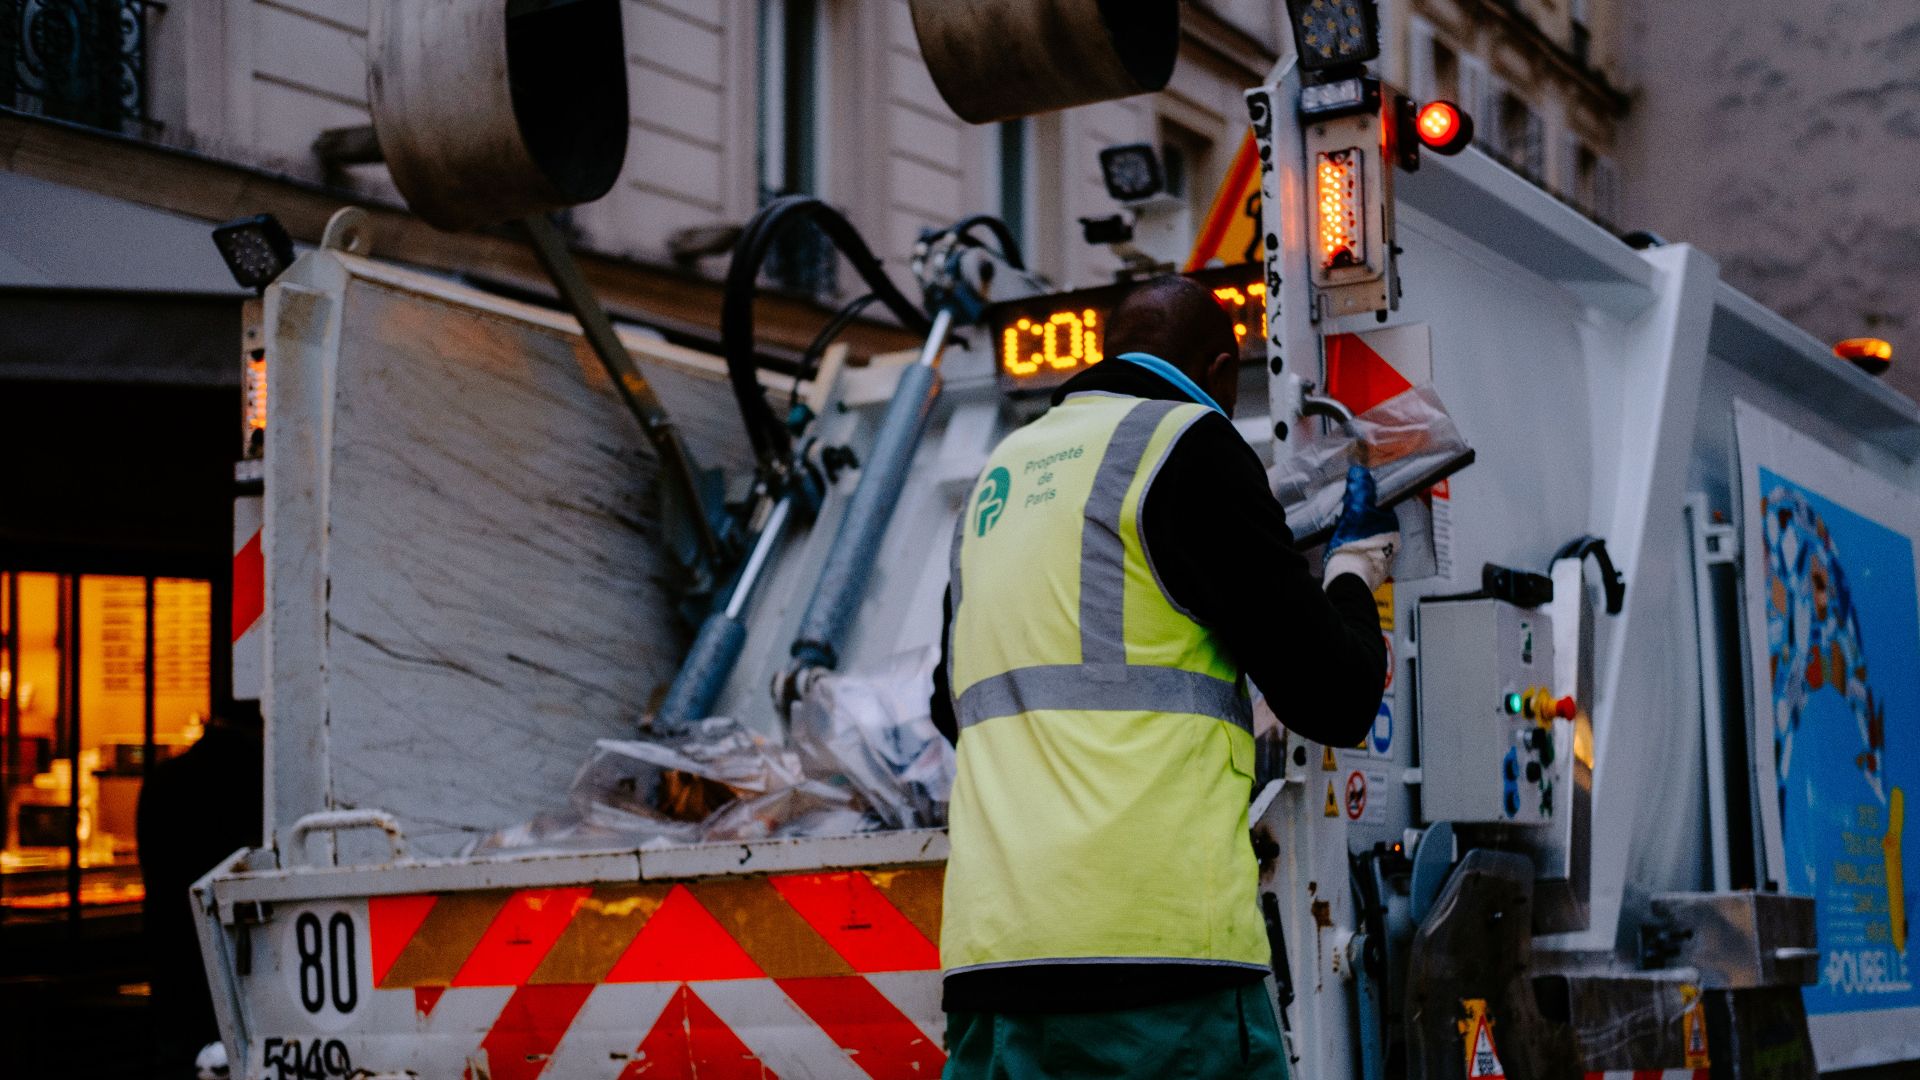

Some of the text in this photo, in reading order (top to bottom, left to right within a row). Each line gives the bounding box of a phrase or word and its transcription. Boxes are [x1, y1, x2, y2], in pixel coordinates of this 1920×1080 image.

[1024, 445, 1084, 474] Propreté
[1037, 472, 1054, 486] de
[1024, 488, 1057, 508] Paris
[296, 912, 357, 1014] 80
